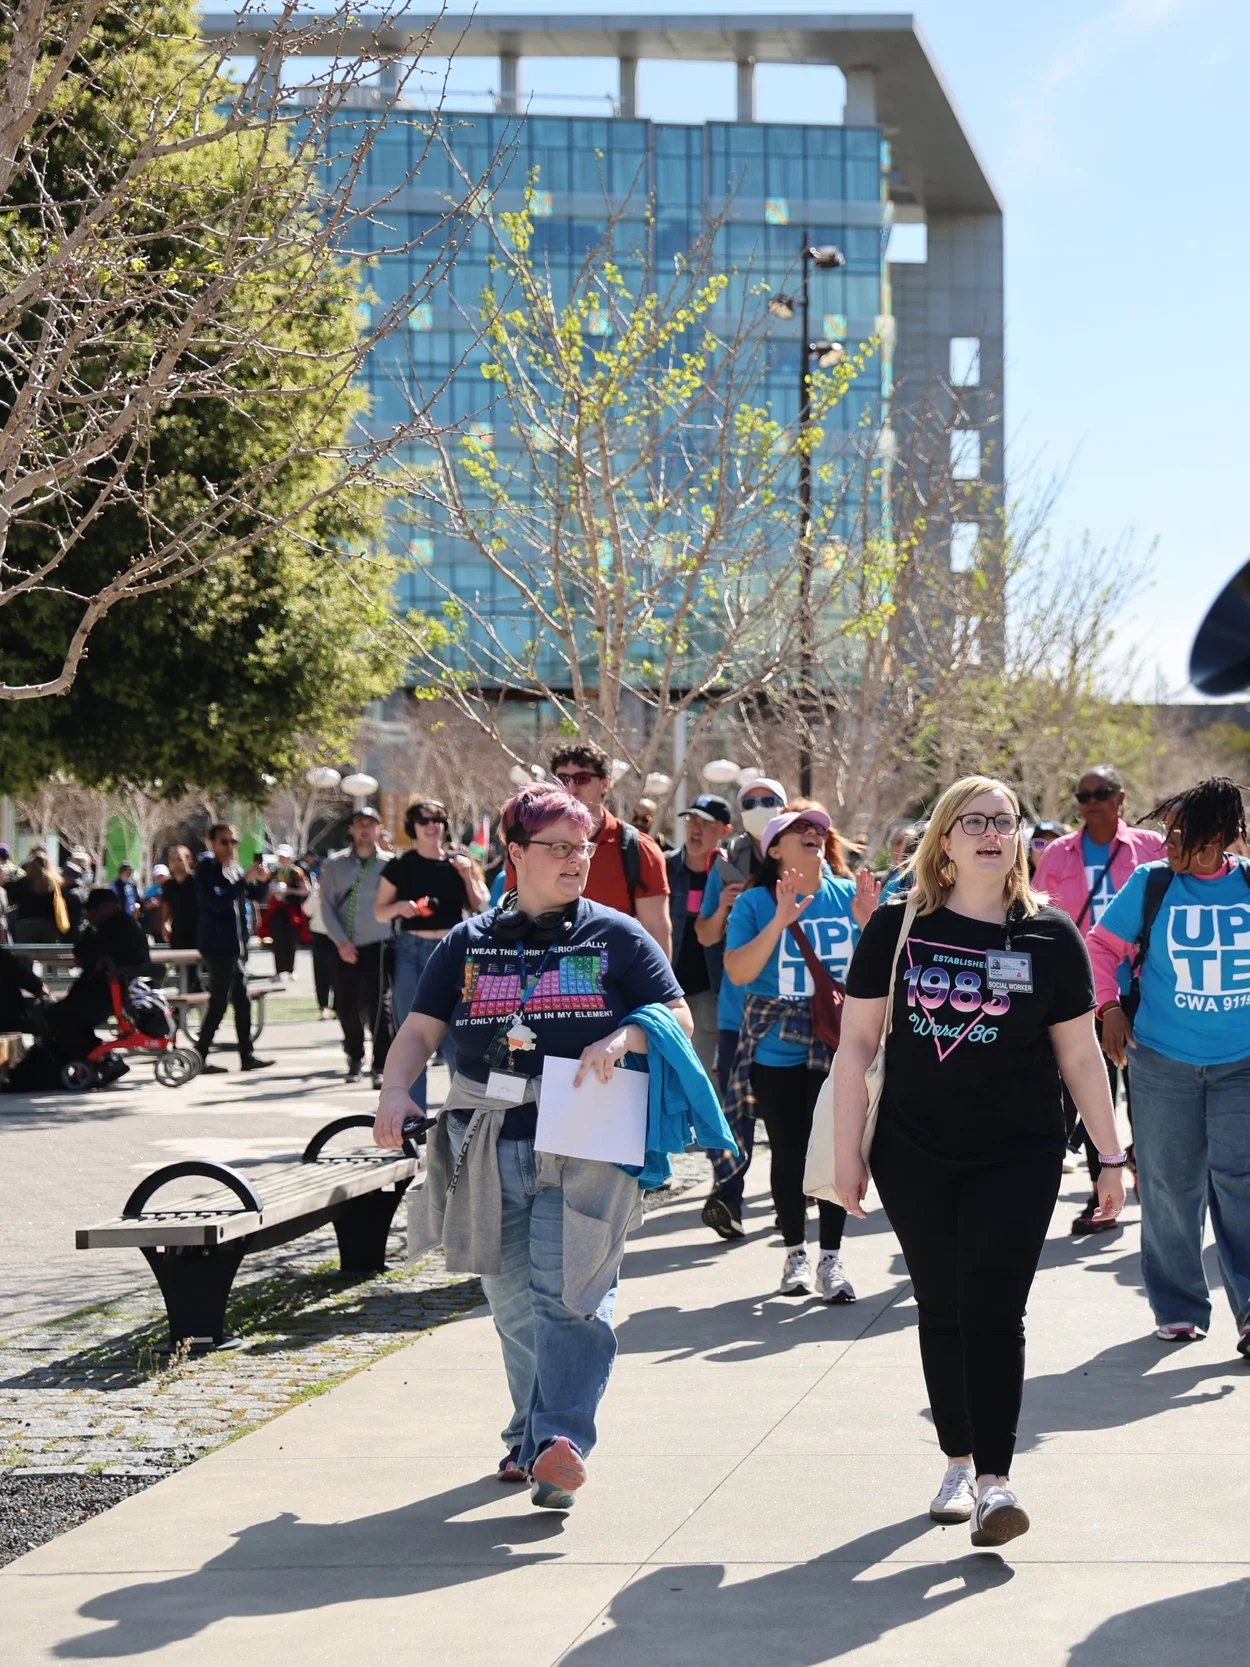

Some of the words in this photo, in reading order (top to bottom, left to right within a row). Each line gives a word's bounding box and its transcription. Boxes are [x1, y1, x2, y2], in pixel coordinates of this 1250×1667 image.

[784, 920, 849, 958] UP
[499, 948, 518, 956] THIS
[988, 981, 1008, 989] SOCIAL
[1008, 983, 1032, 992] WORKER
[1174, 993, 1219, 1012] CWA
[470, 1017, 494, 1025] ONLY
[575, 1010, 613, 1018] ELEMENT
[908, 1012, 965, 1039] Ward
[967, 1024, 999, 1044] 86
